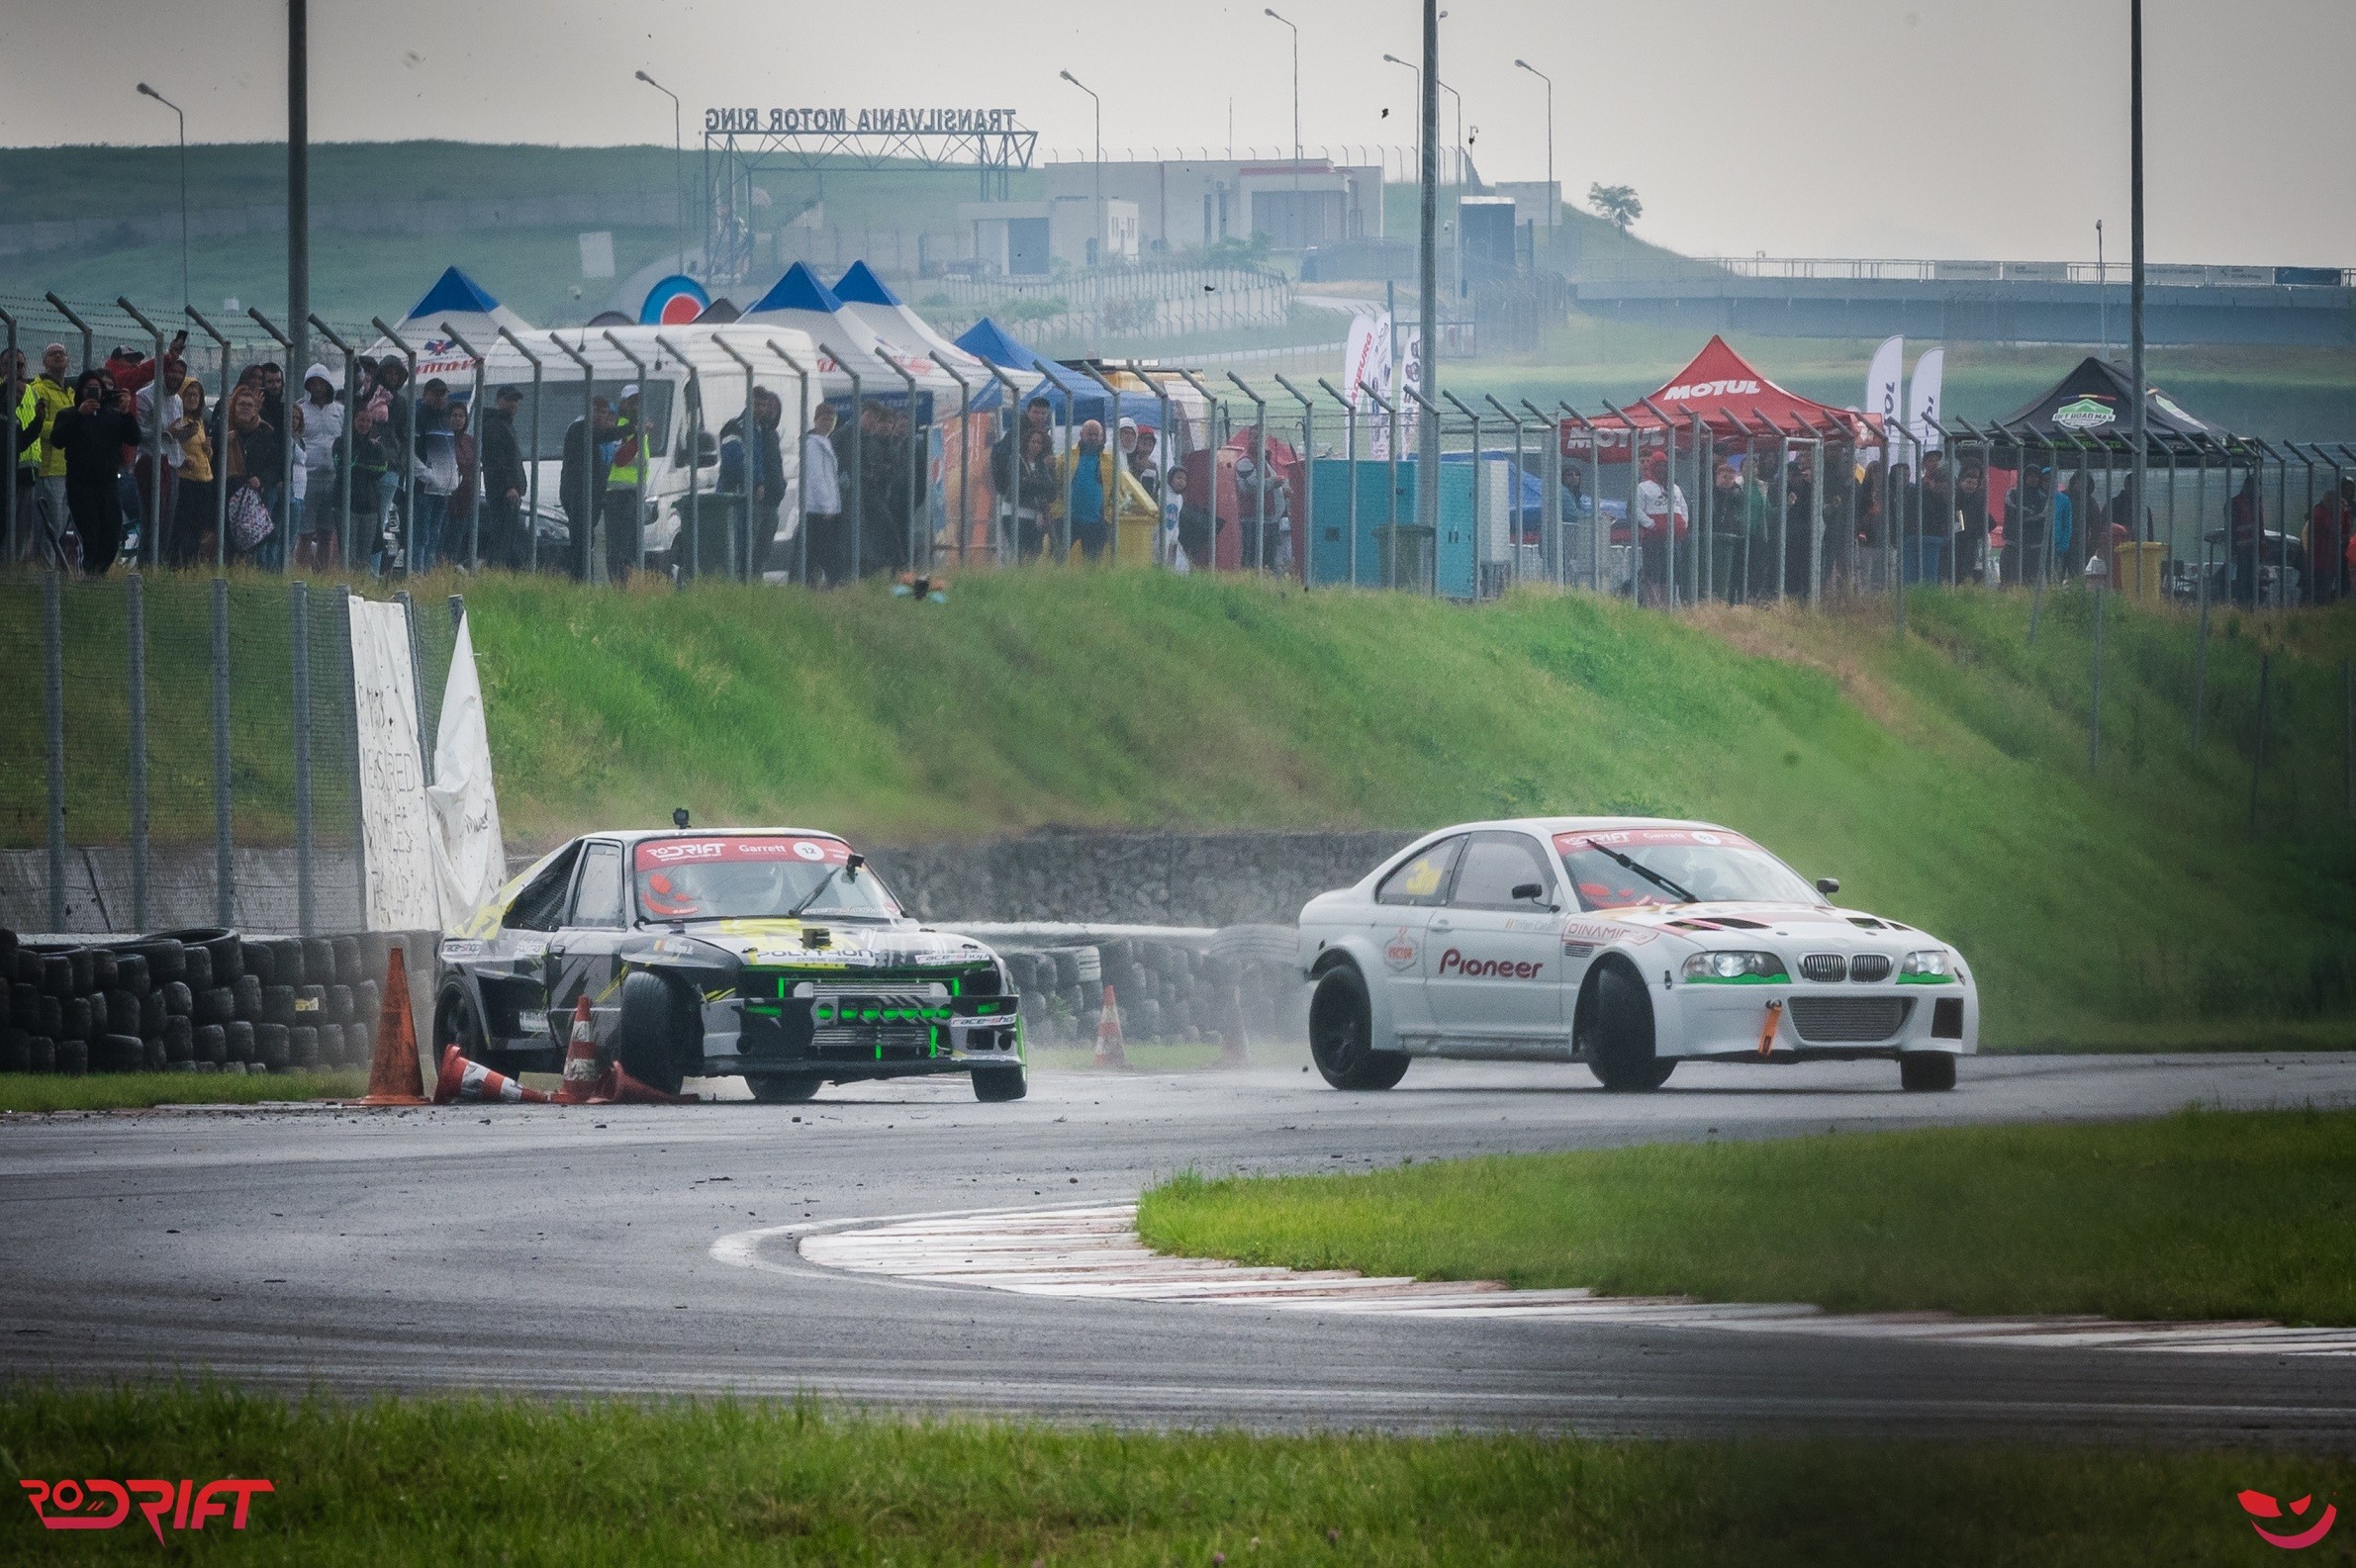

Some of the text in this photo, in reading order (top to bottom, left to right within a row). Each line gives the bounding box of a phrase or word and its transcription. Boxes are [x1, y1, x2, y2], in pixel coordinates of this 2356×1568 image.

[1663, 380, 1760, 401] MOTUL
[739, 844, 786, 853] Garrett
[1439, 949, 1543, 978] Pioneer
